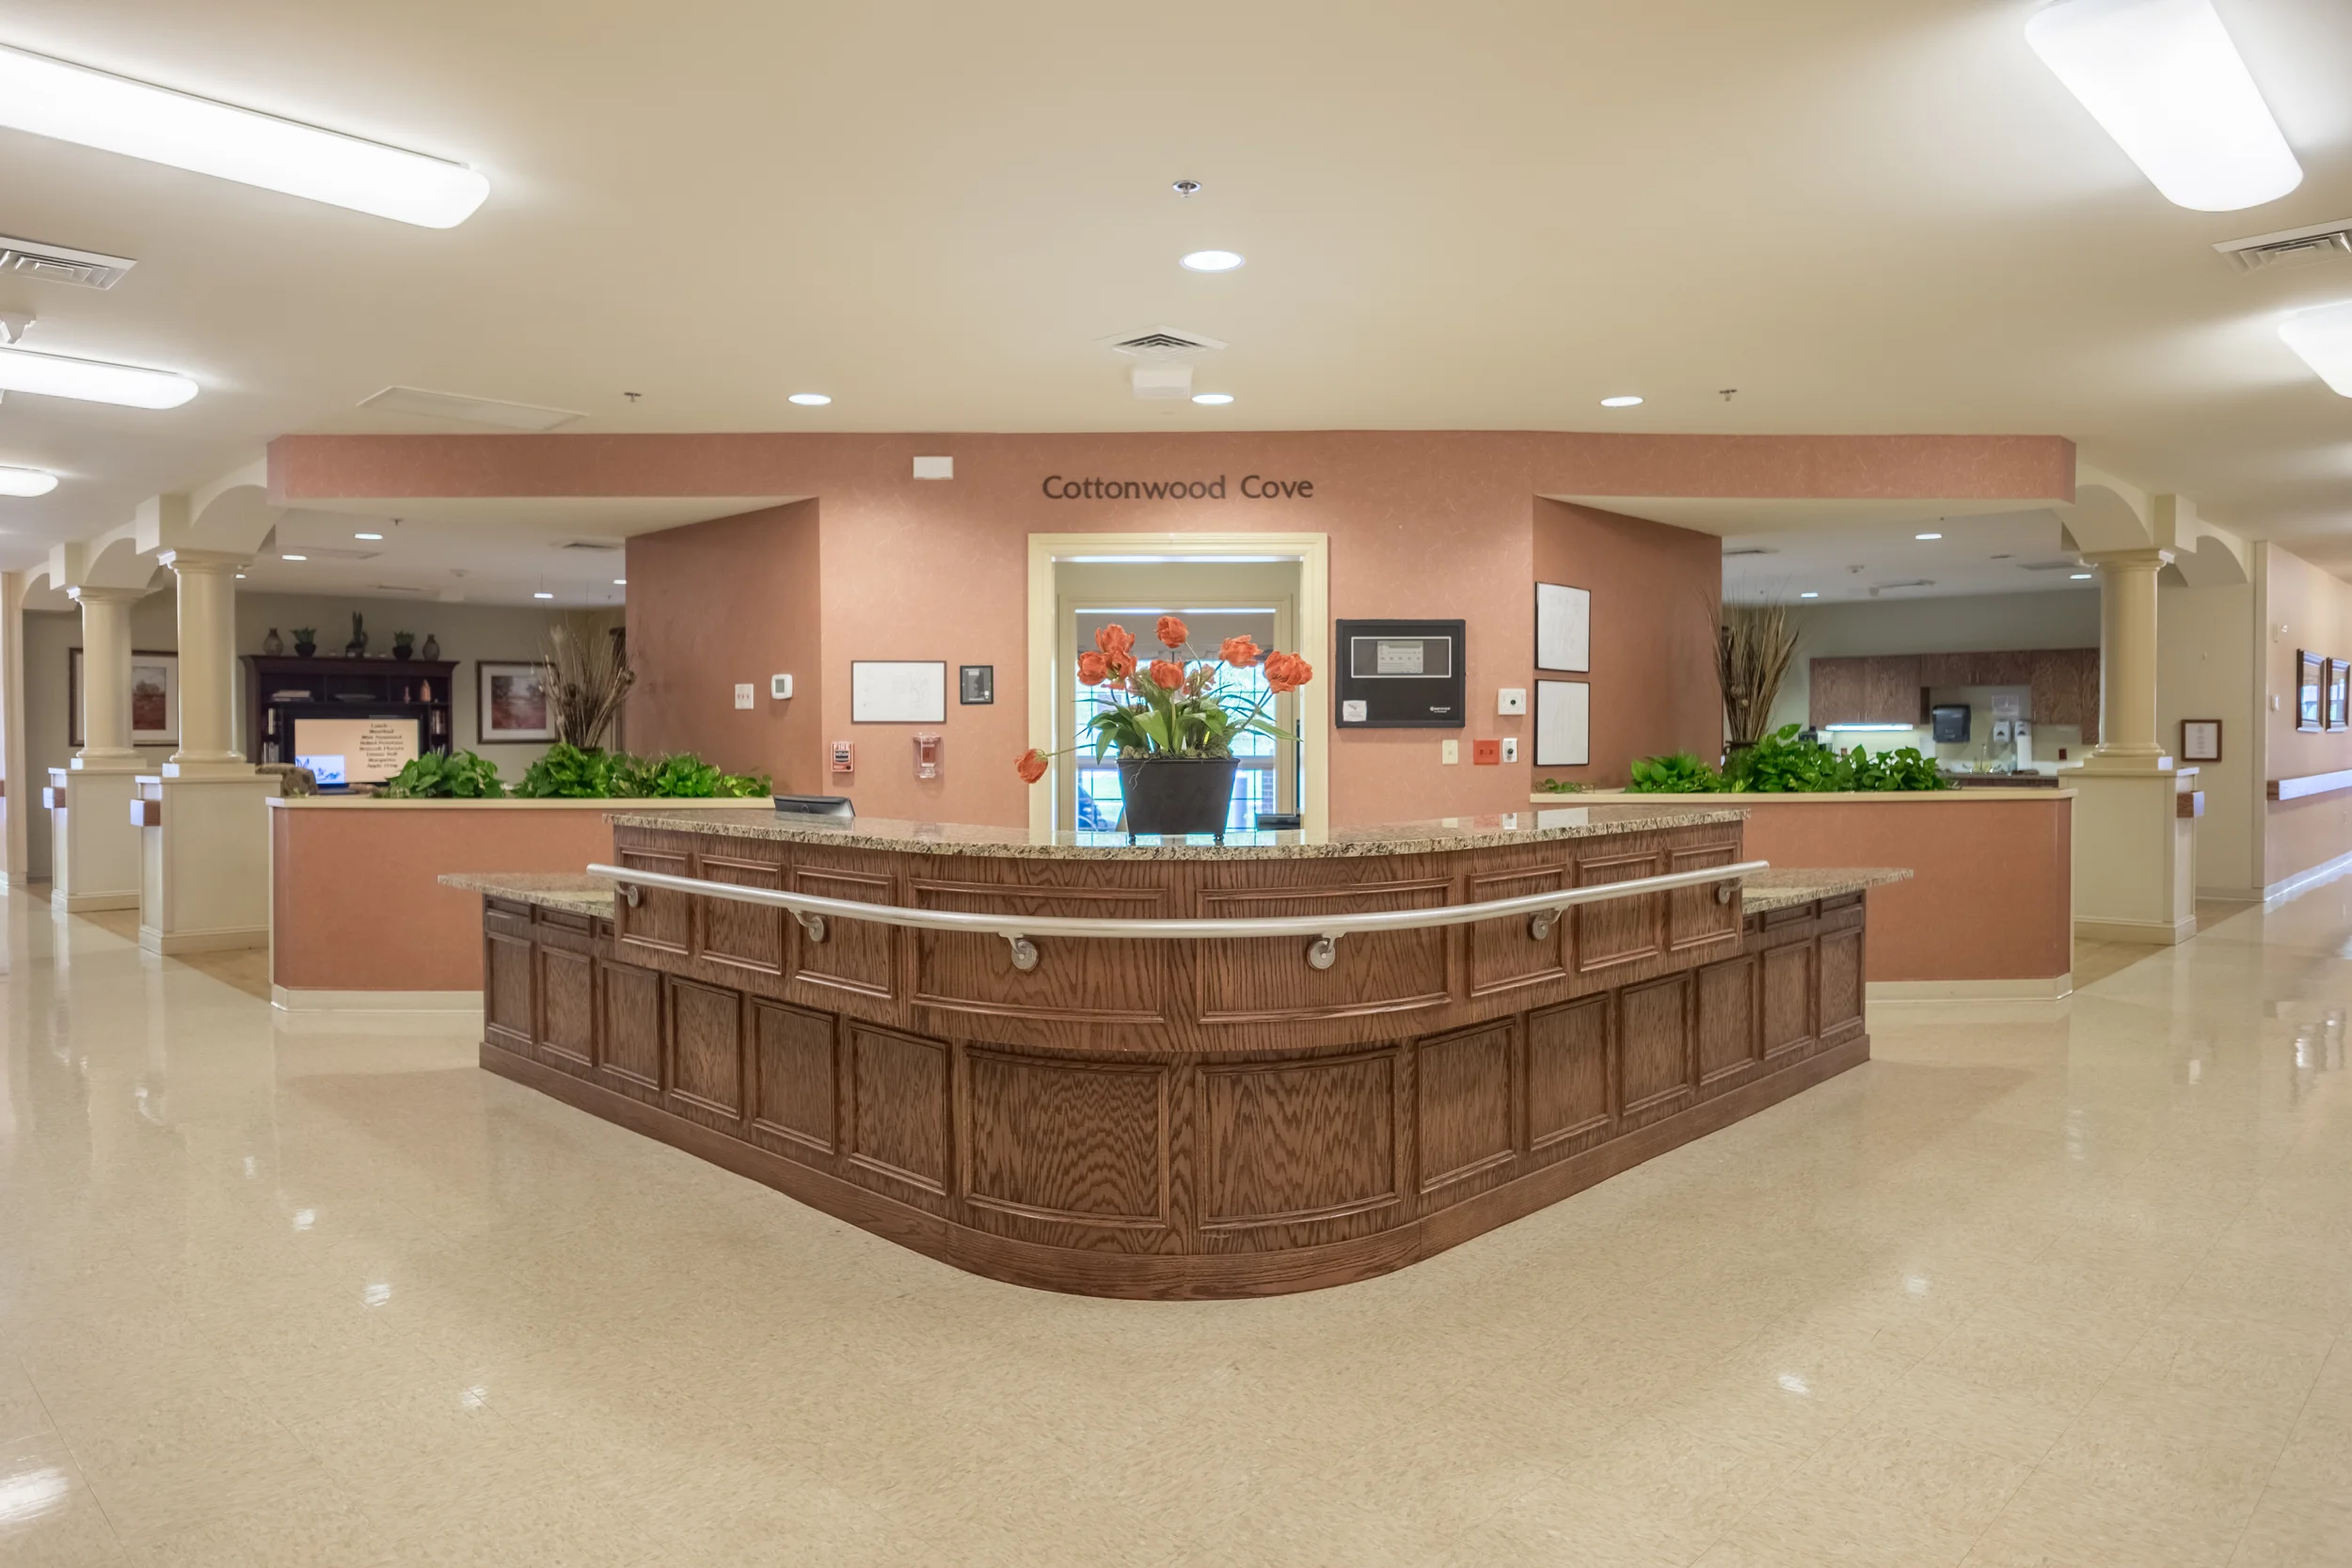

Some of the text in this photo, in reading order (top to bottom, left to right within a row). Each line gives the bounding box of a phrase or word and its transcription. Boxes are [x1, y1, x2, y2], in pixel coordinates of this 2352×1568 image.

[1042, 475, 1313, 499] Cottonwood Cove
[834, 742, 850, 751] FIRE
